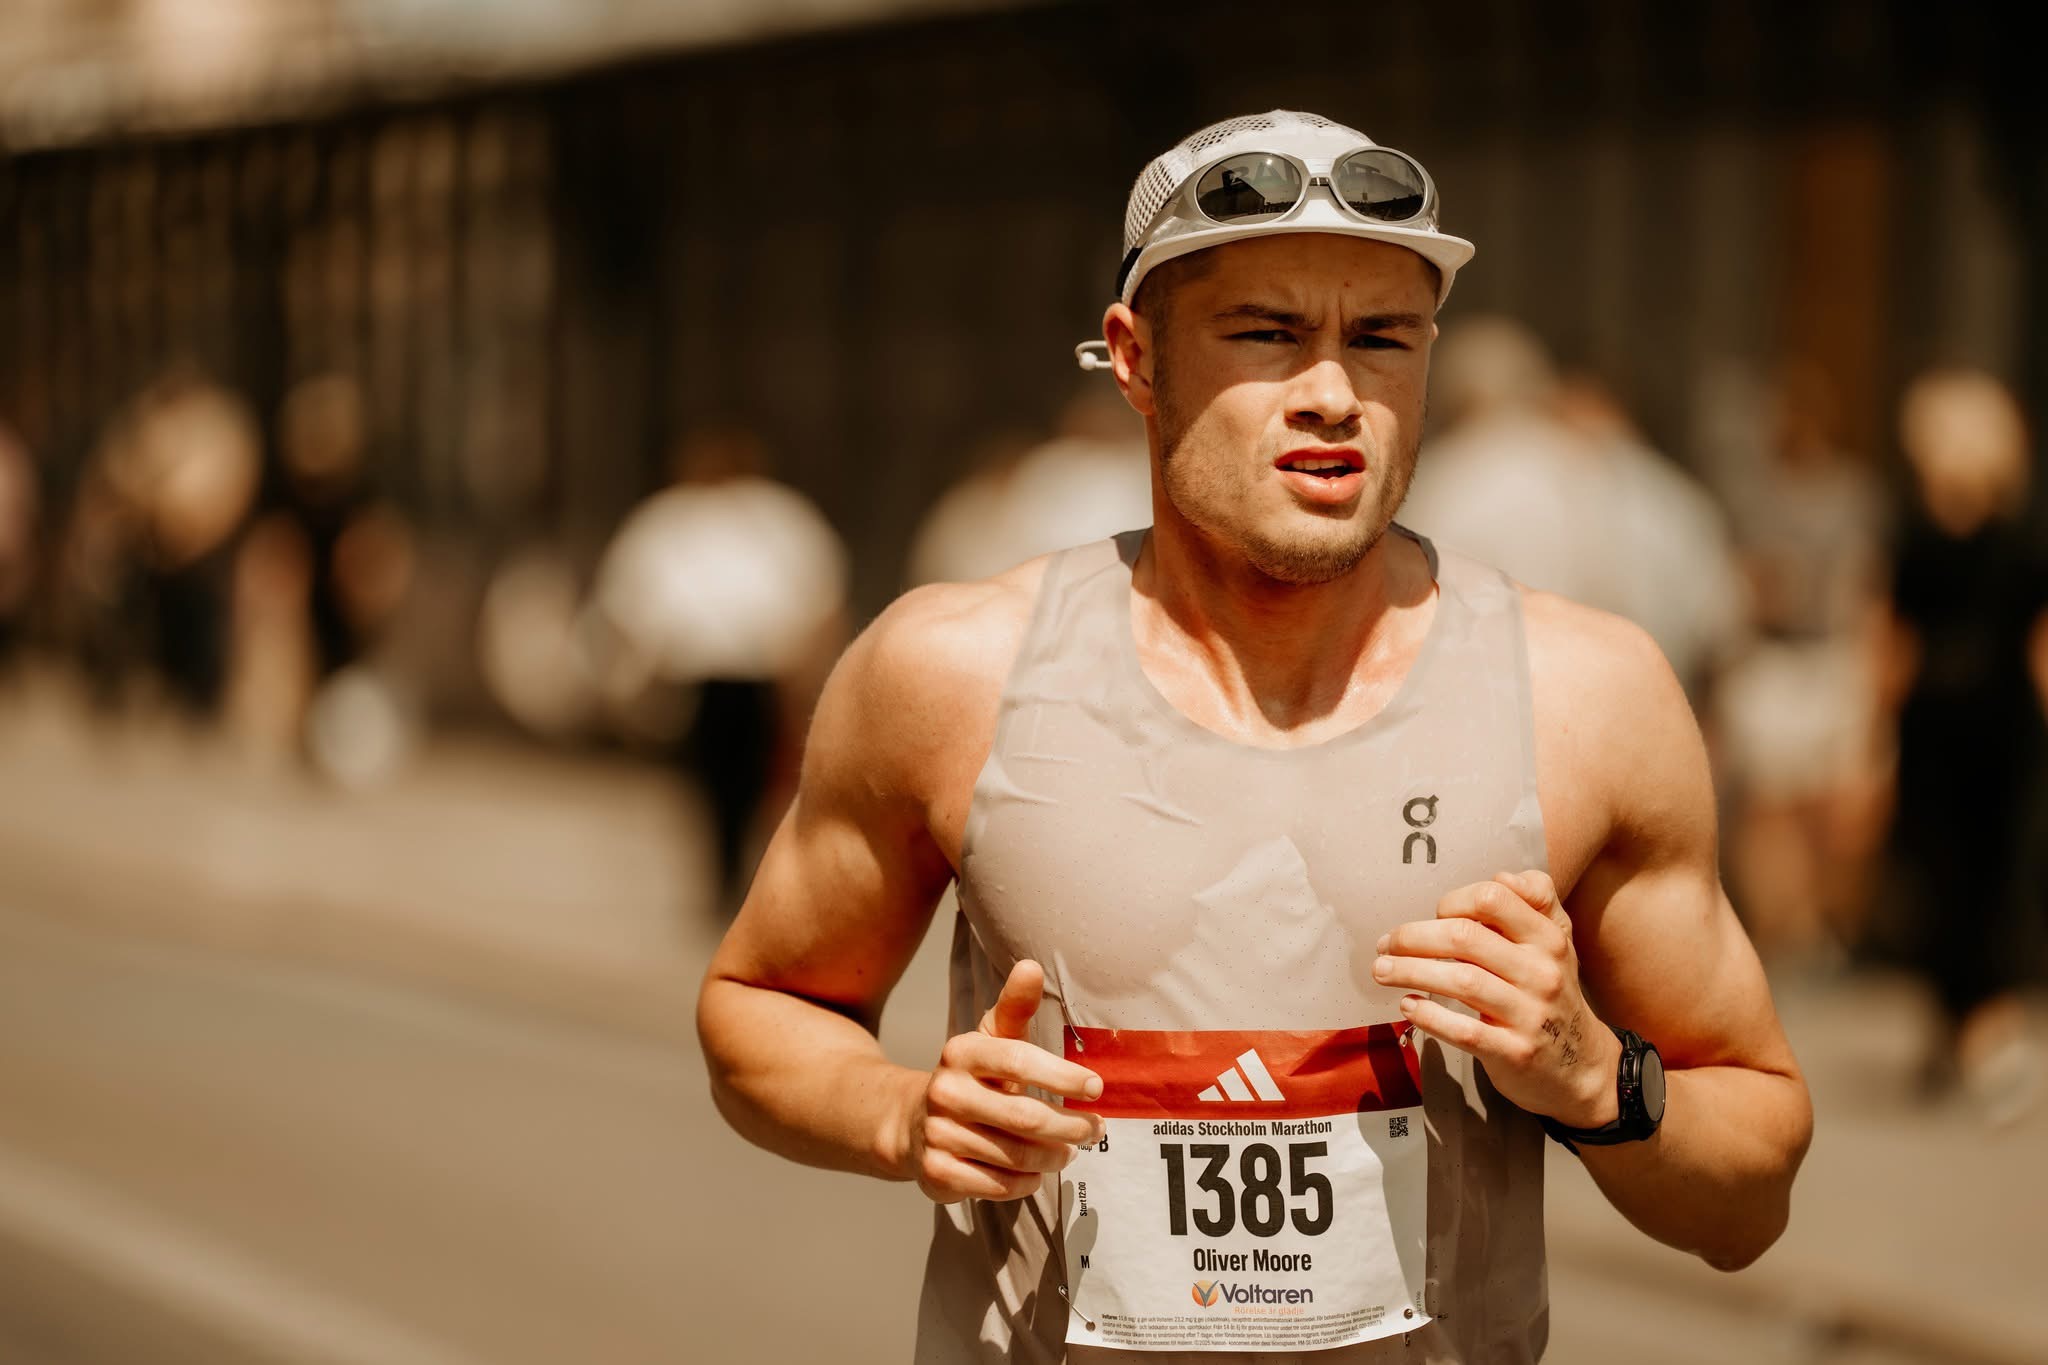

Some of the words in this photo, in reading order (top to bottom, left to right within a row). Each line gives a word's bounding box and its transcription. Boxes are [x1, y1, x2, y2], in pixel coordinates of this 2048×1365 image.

[1153, 1121, 1195, 1136] adidas
[1198, 1121, 1267, 1136] Stockholm
[1271, 1120, 1332, 1136] Marathon
[1160, 1141, 1334, 1238] 1385
[1079, 1199, 1088, 1217] Start
[1080, 1255, 1090, 1269] M
[1193, 1248, 1248, 1272] Oliver
[1252, 1248, 1312, 1272] Moore
[1220, 1283, 1314, 1304] Voltaren
